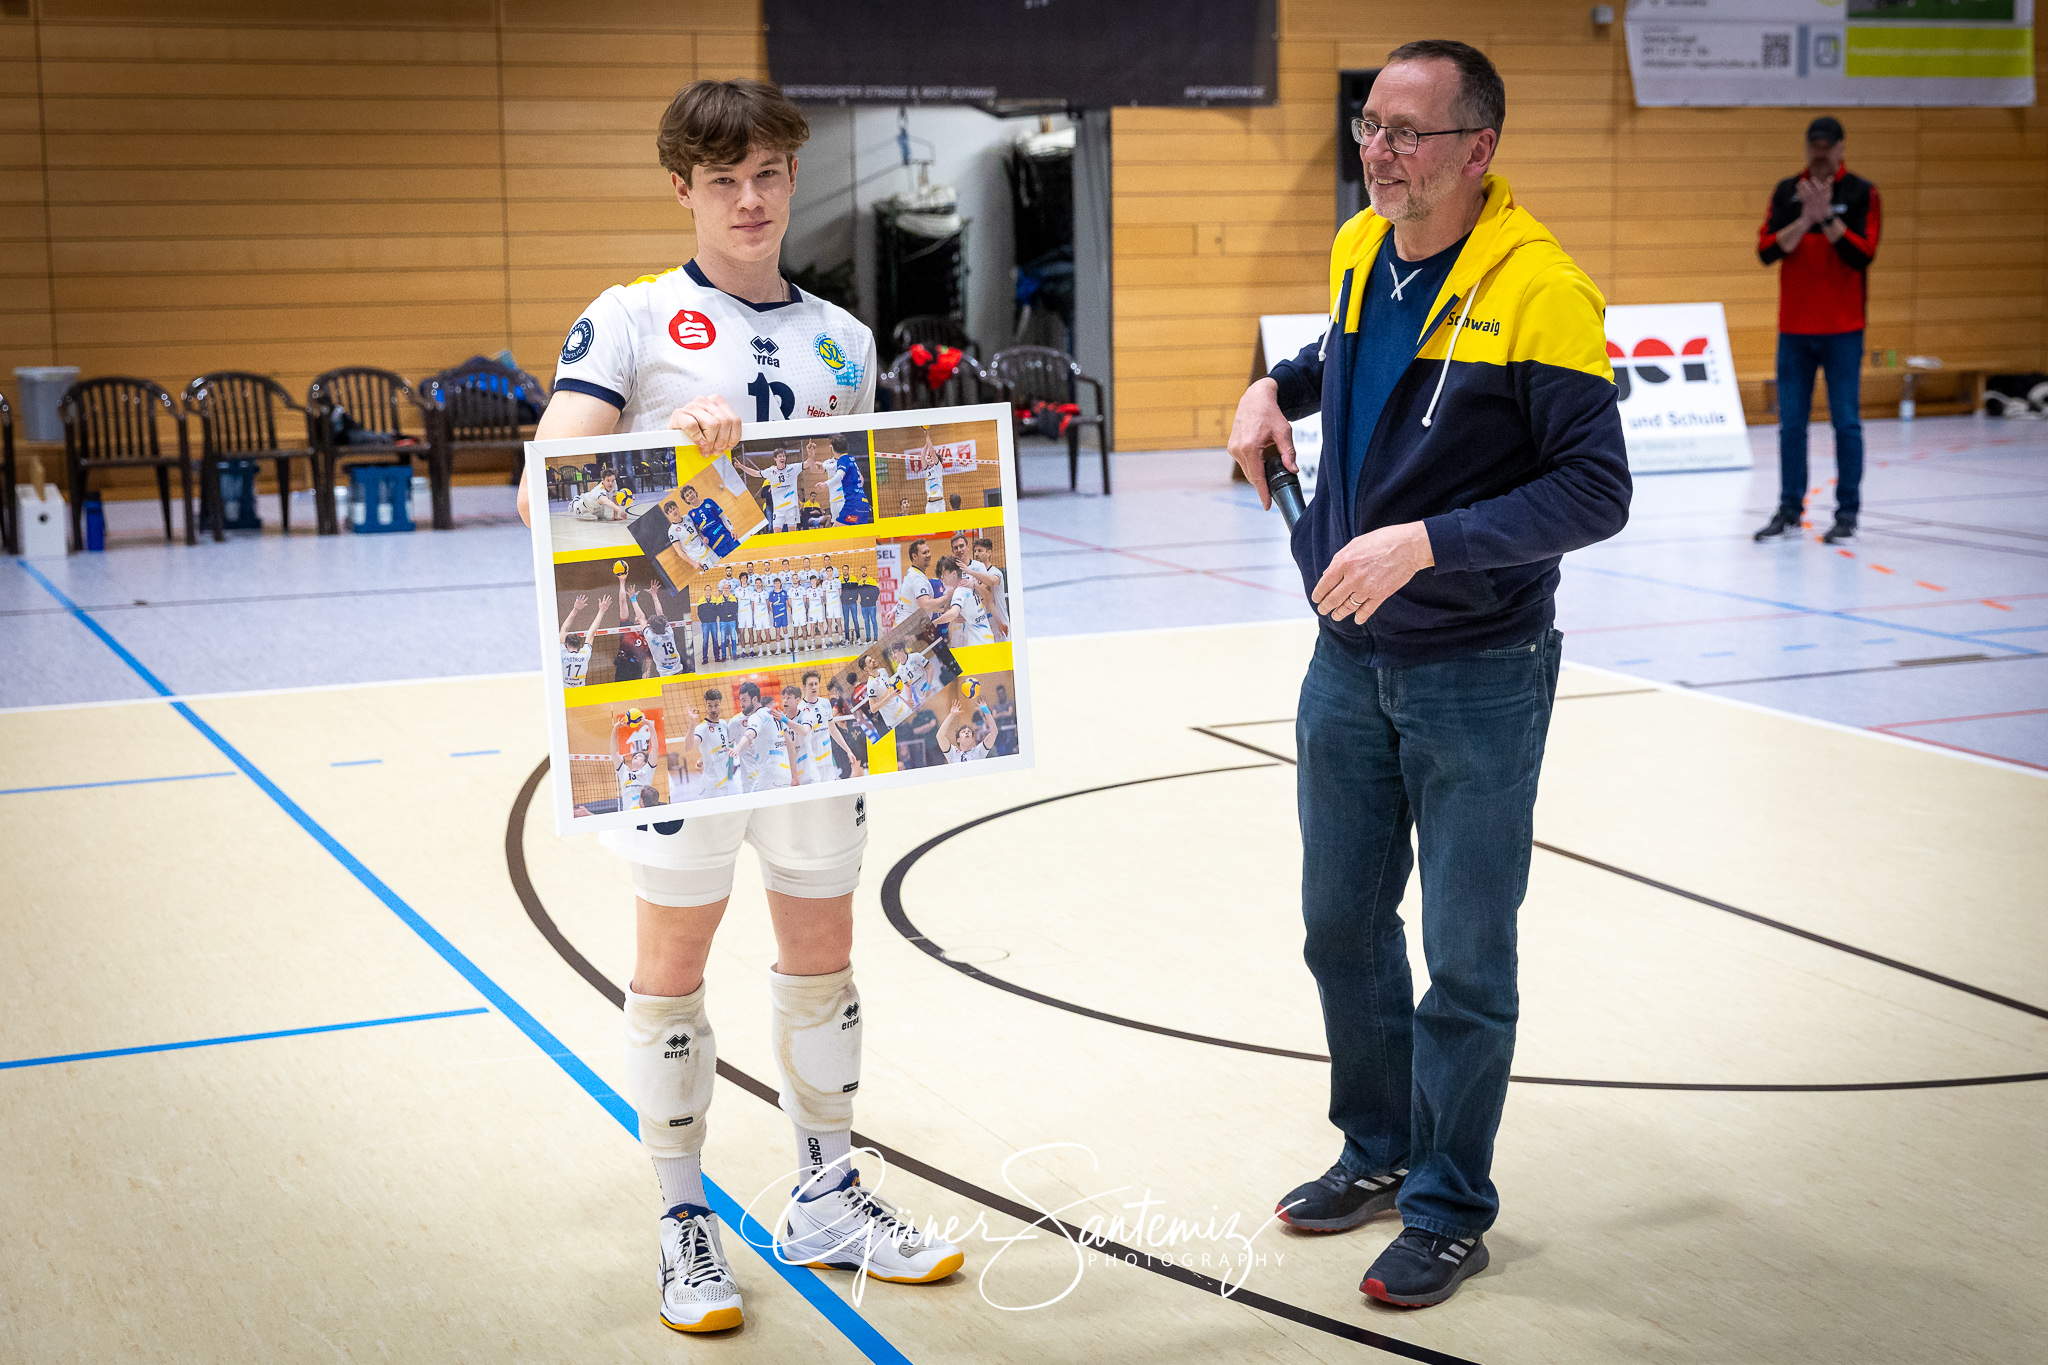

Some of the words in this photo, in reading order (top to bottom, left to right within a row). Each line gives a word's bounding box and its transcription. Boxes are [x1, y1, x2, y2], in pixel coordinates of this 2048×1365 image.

[1667, 411, 1726, 427] Schule
[662, 641, 675, 655] 13
[566, 663, 582, 677] 17
[816, 713, 823, 724] 2
